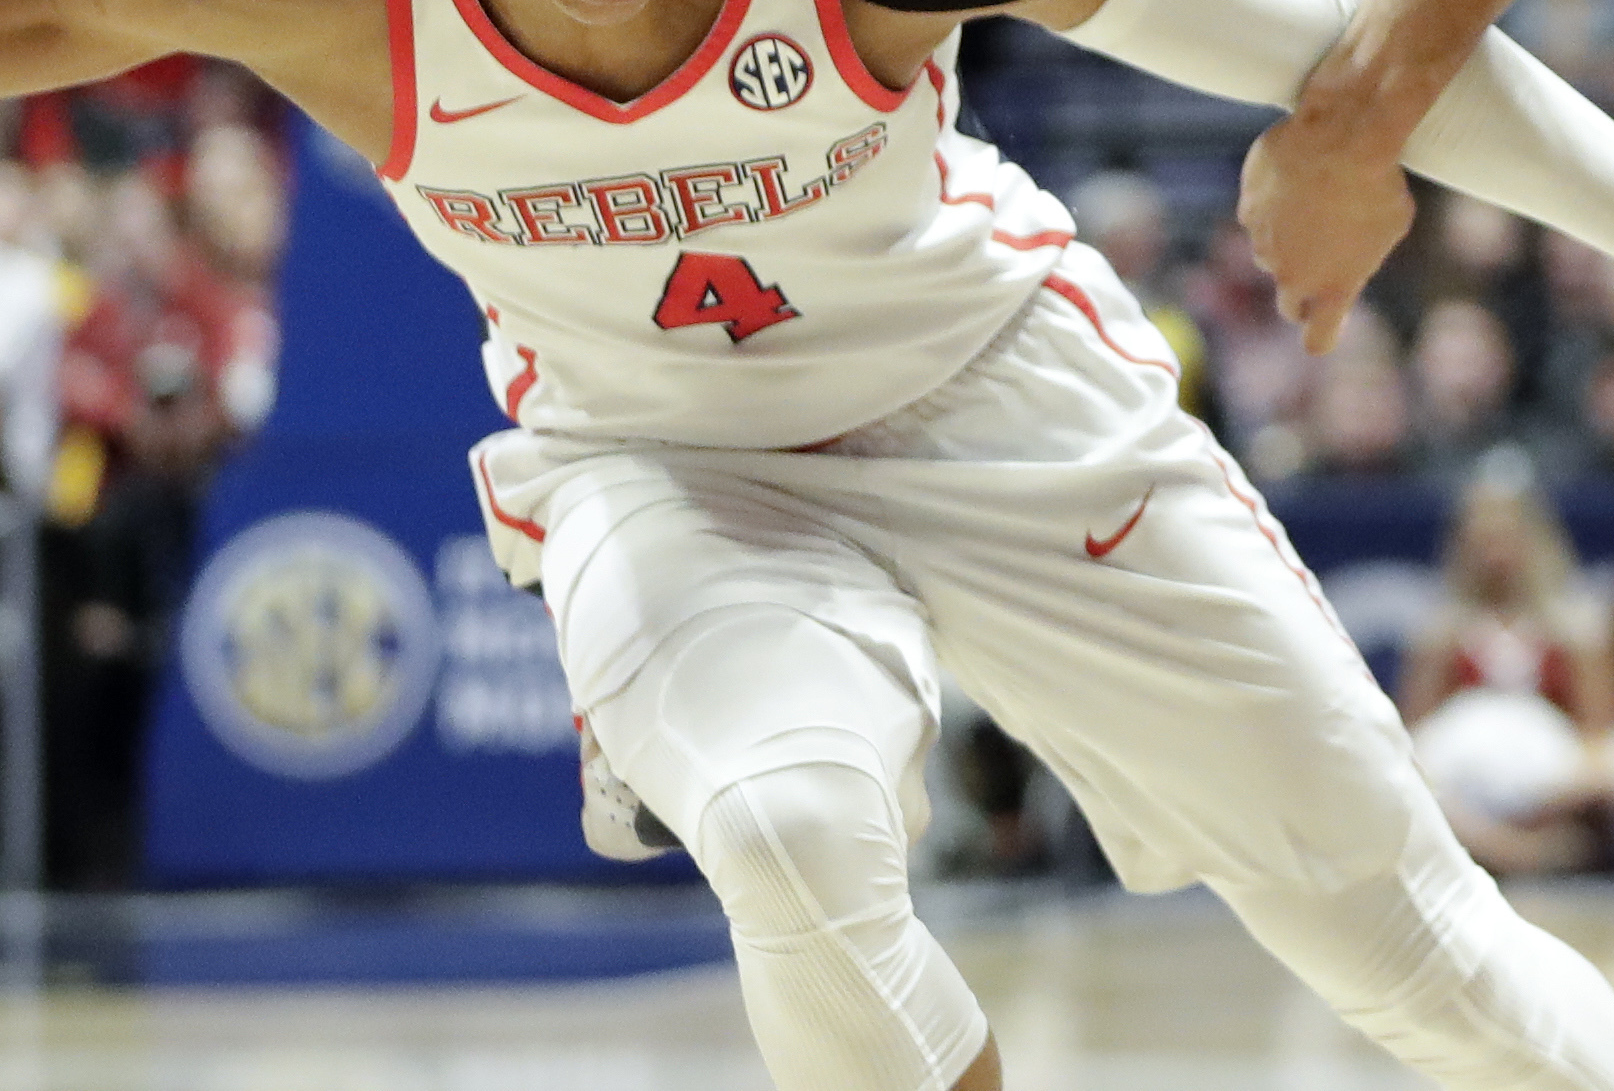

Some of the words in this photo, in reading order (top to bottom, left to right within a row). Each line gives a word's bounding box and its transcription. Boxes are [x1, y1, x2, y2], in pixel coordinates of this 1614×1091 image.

[734, 39, 808, 108] SEC
[416, 122, 887, 246] REBELS
[652, 250, 803, 344] 4
